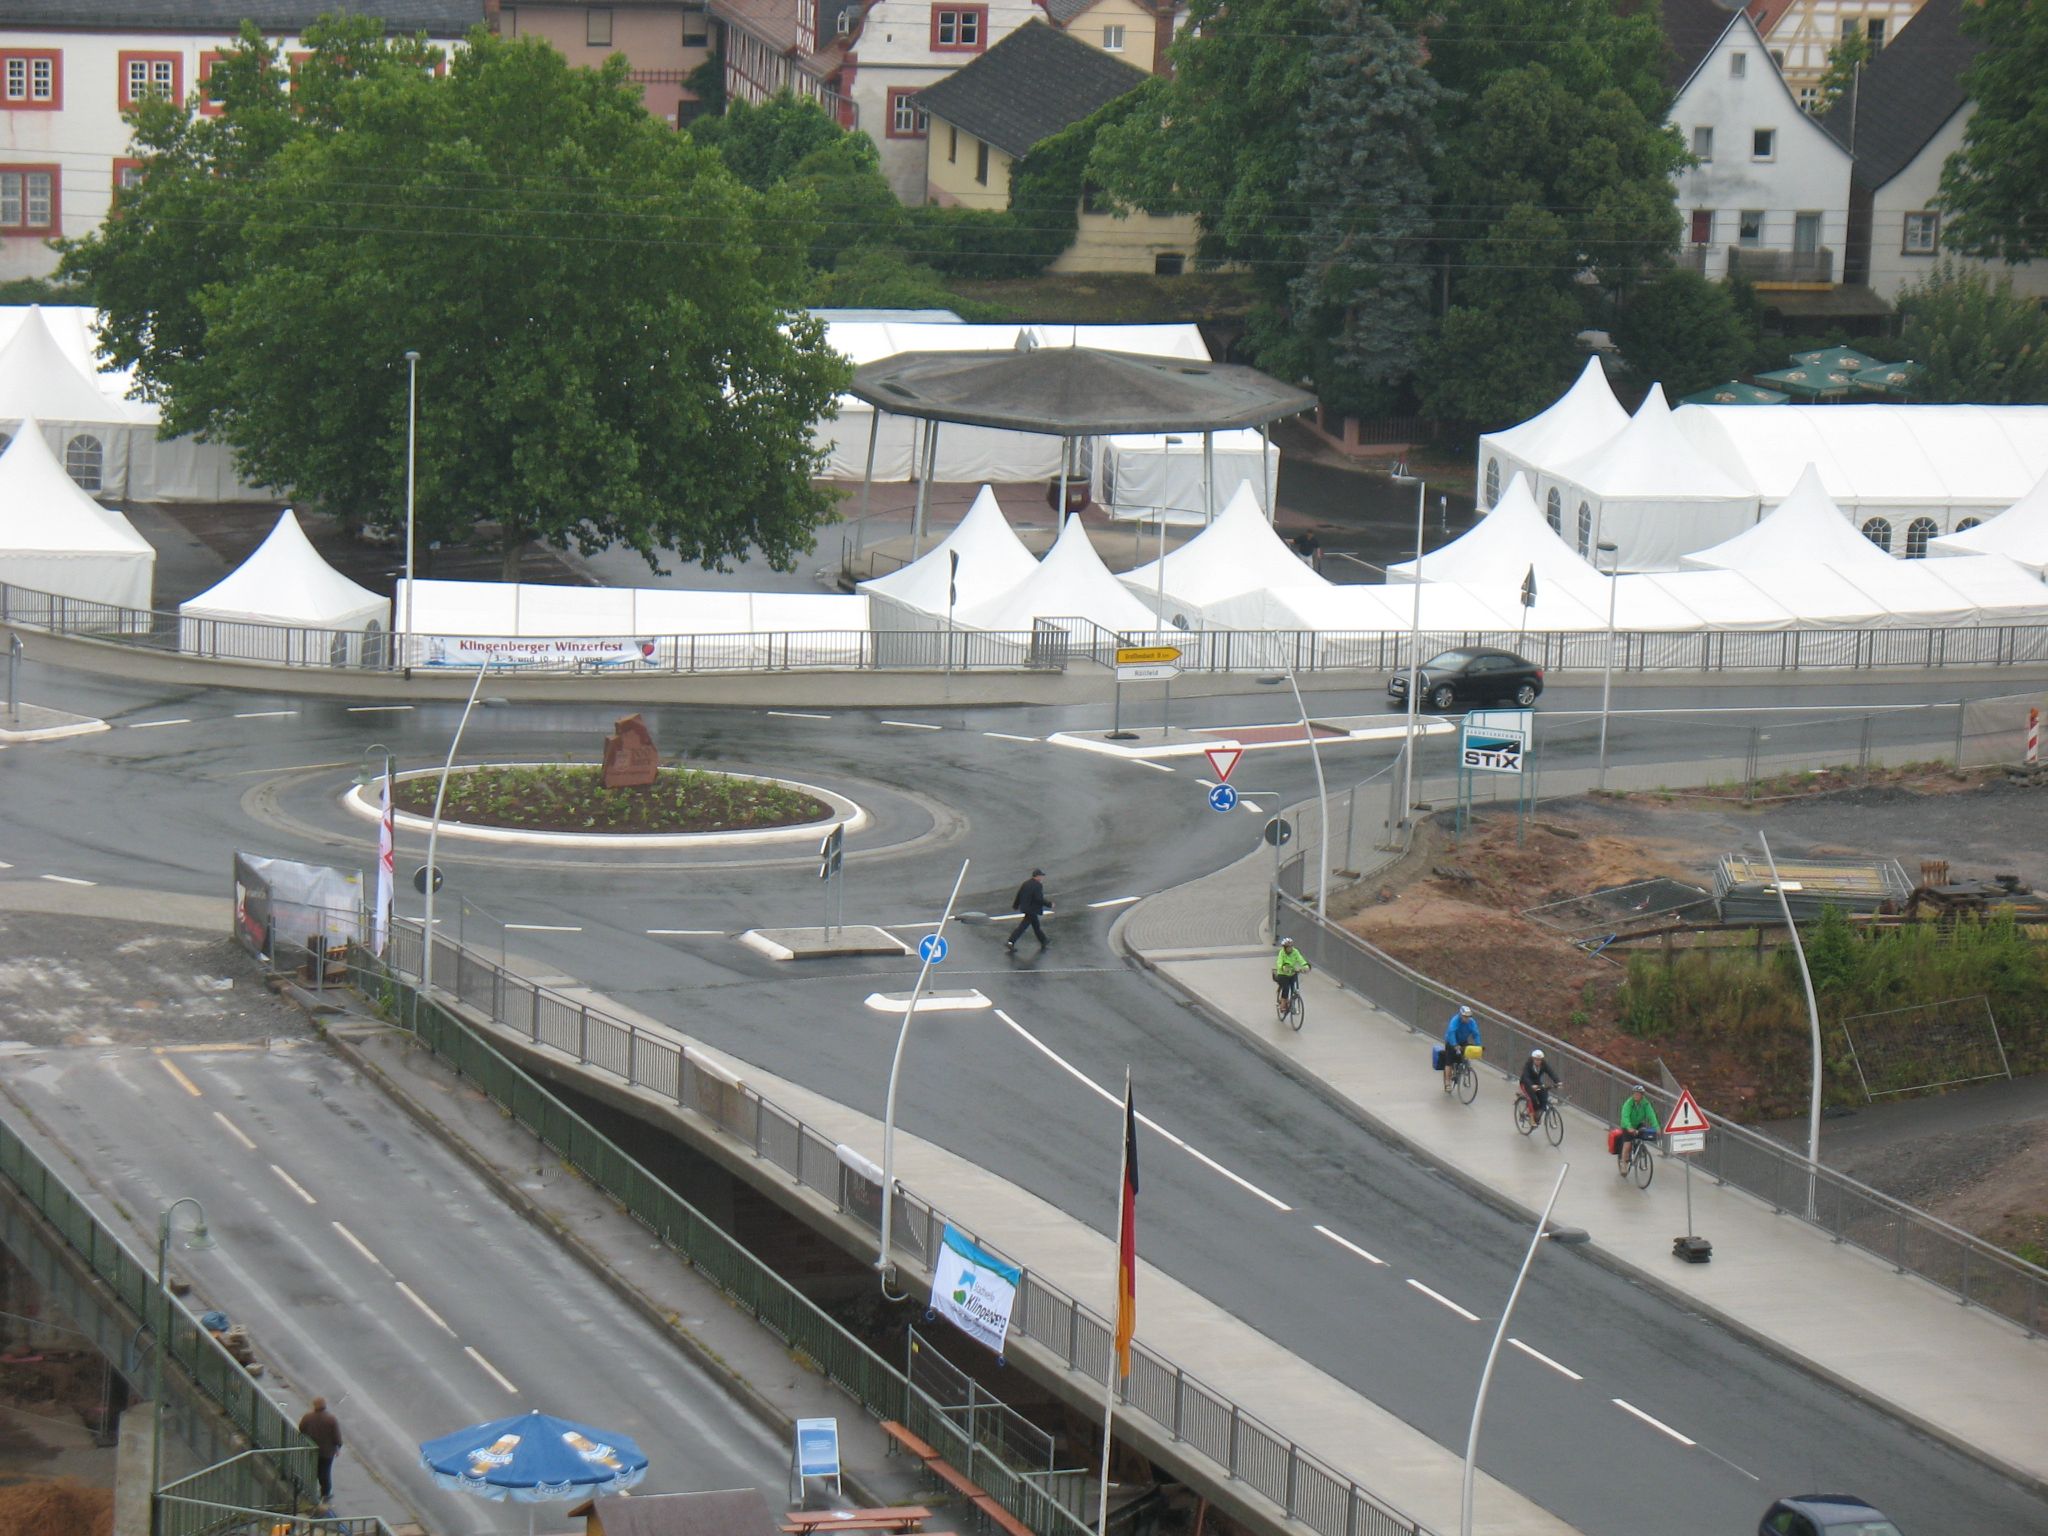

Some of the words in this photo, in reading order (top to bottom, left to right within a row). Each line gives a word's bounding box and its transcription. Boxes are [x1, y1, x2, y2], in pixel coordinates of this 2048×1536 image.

[459, 639, 550, 654] Klingenberger
[555, 641, 623, 652] Winzerfest
[518, 655, 535, 663] und
[573, 655, 603, 665] August
